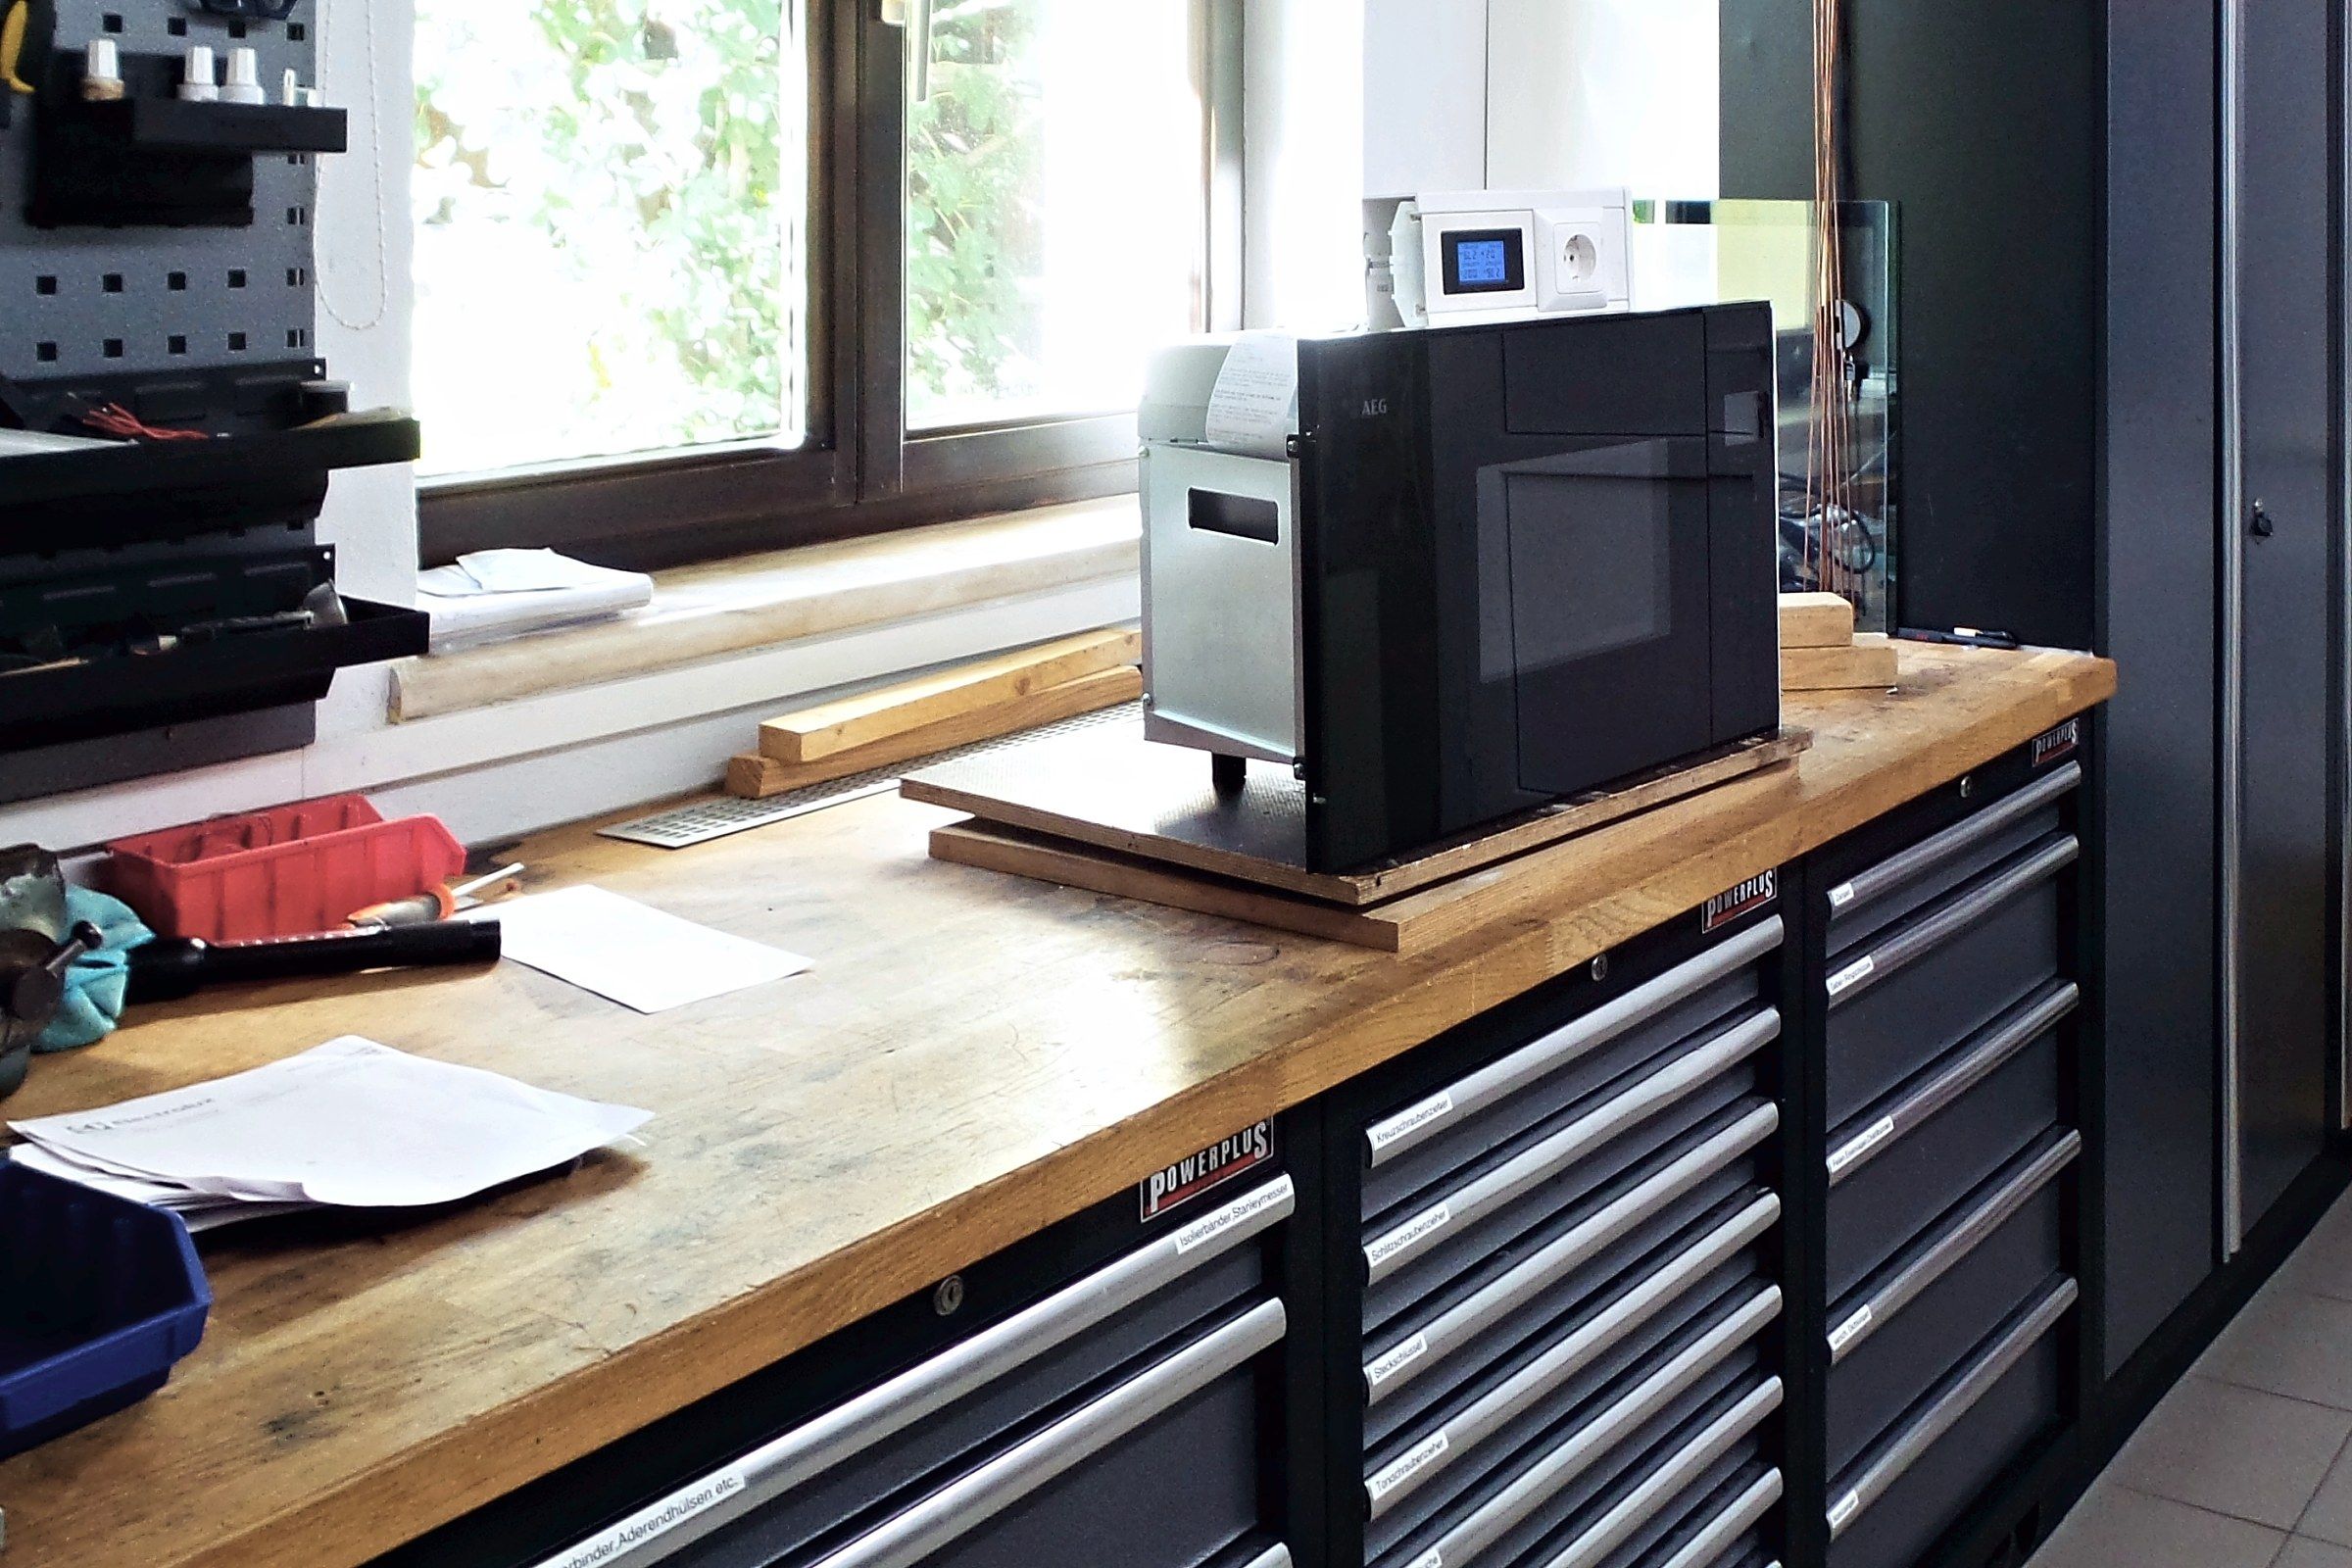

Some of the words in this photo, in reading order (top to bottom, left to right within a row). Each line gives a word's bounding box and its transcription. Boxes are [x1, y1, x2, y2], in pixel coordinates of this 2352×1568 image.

[1362, 399, 1387, 416] AEG
[2035, 721, 2077, 762] POWERPLUS
[1707, 870, 1773, 927] POWERPLUS
[1150, 1121, 1268, 1213] POWERPLUS
[715, 1477, 738, 1494] etc.
